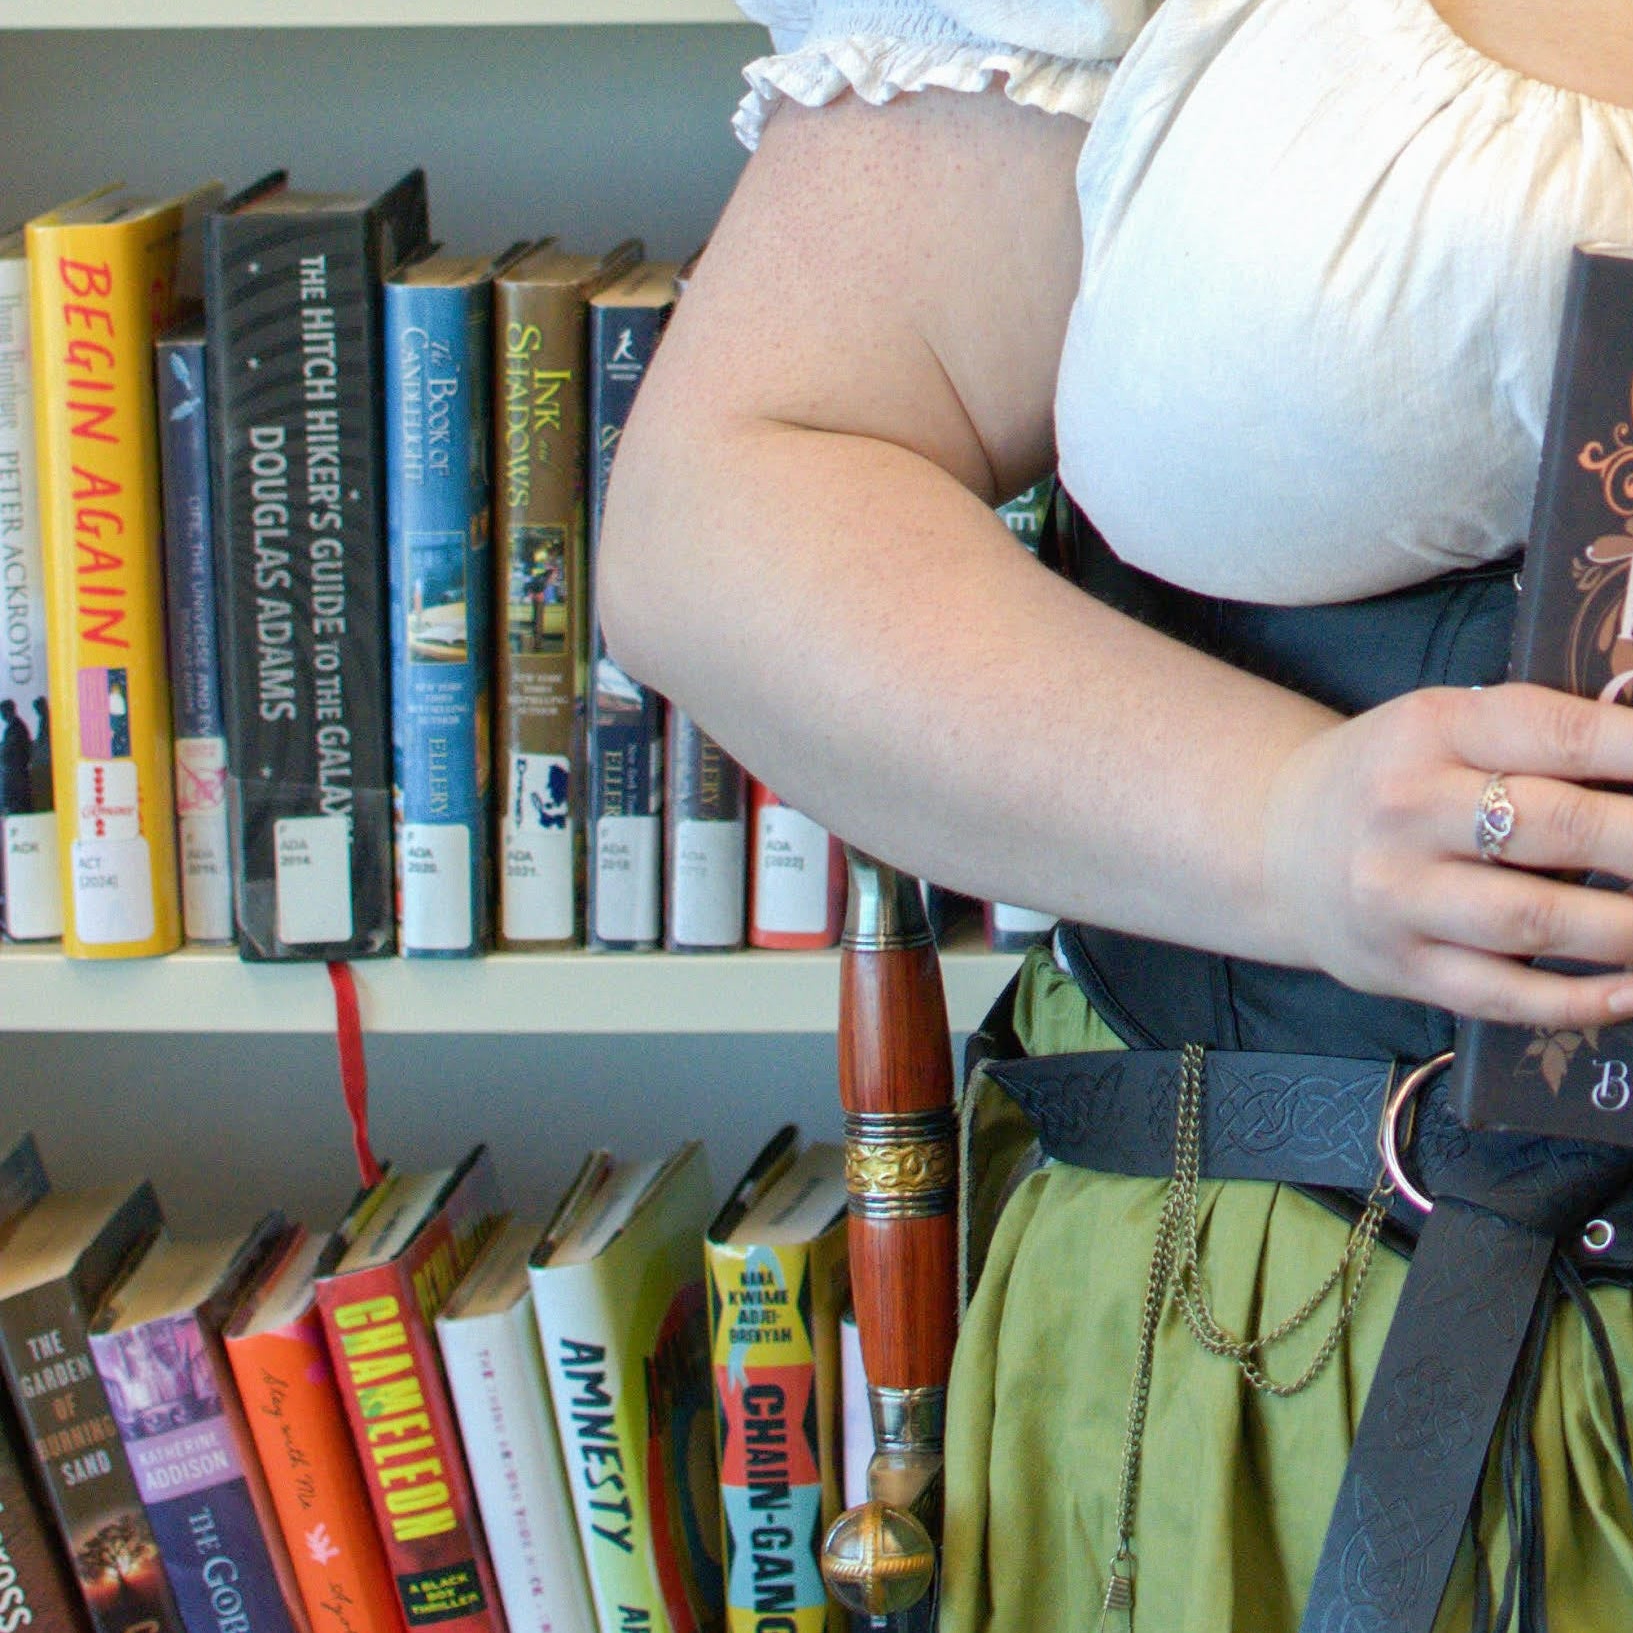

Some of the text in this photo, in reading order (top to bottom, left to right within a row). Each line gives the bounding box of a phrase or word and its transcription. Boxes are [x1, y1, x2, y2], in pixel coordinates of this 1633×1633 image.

[399, 327, 428, 486] CANDLELIGHT
[427, 378, 459, 442] BOOK
[503, 322, 543, 508] SHADOWS
[531, 368, 572, 432] INK
[57, 257, 131, 651] BEGIN AGAIN
[428, 447, 450, 477] OF
[299, 255, 347, 719] THE HITCH HIKER'S GUIDE TO THE
[249, 427, 298, 722] DOUGLAS ADAMS
[2, 548, 35, 686] ACKROYD
[427, 737, 450, 816] ELLERY
[728, 1289, 790, 1306] KWAME
[739, 1270, 775, 1286] NANA
[20, 1353, 94, 1399] GARDEN
[25, 1329, 65, 1362] THE
[53, 1392, 77, 1422] OF
[259, 1368, 317, 1510] Stay with Me
[333, 1295, 458, 1543] CHAMELEON
[60, 1449, 113, 1486] SAND
[145, 1449, 230, 1490] ADDISON
[559, 1338, 634, 1555] AMNESTY
[410, 1593, 481, 1615] THRILLER
[422, 1570, 469, 1592] BLACK
[425, 1586, 455, 1600] BOY
